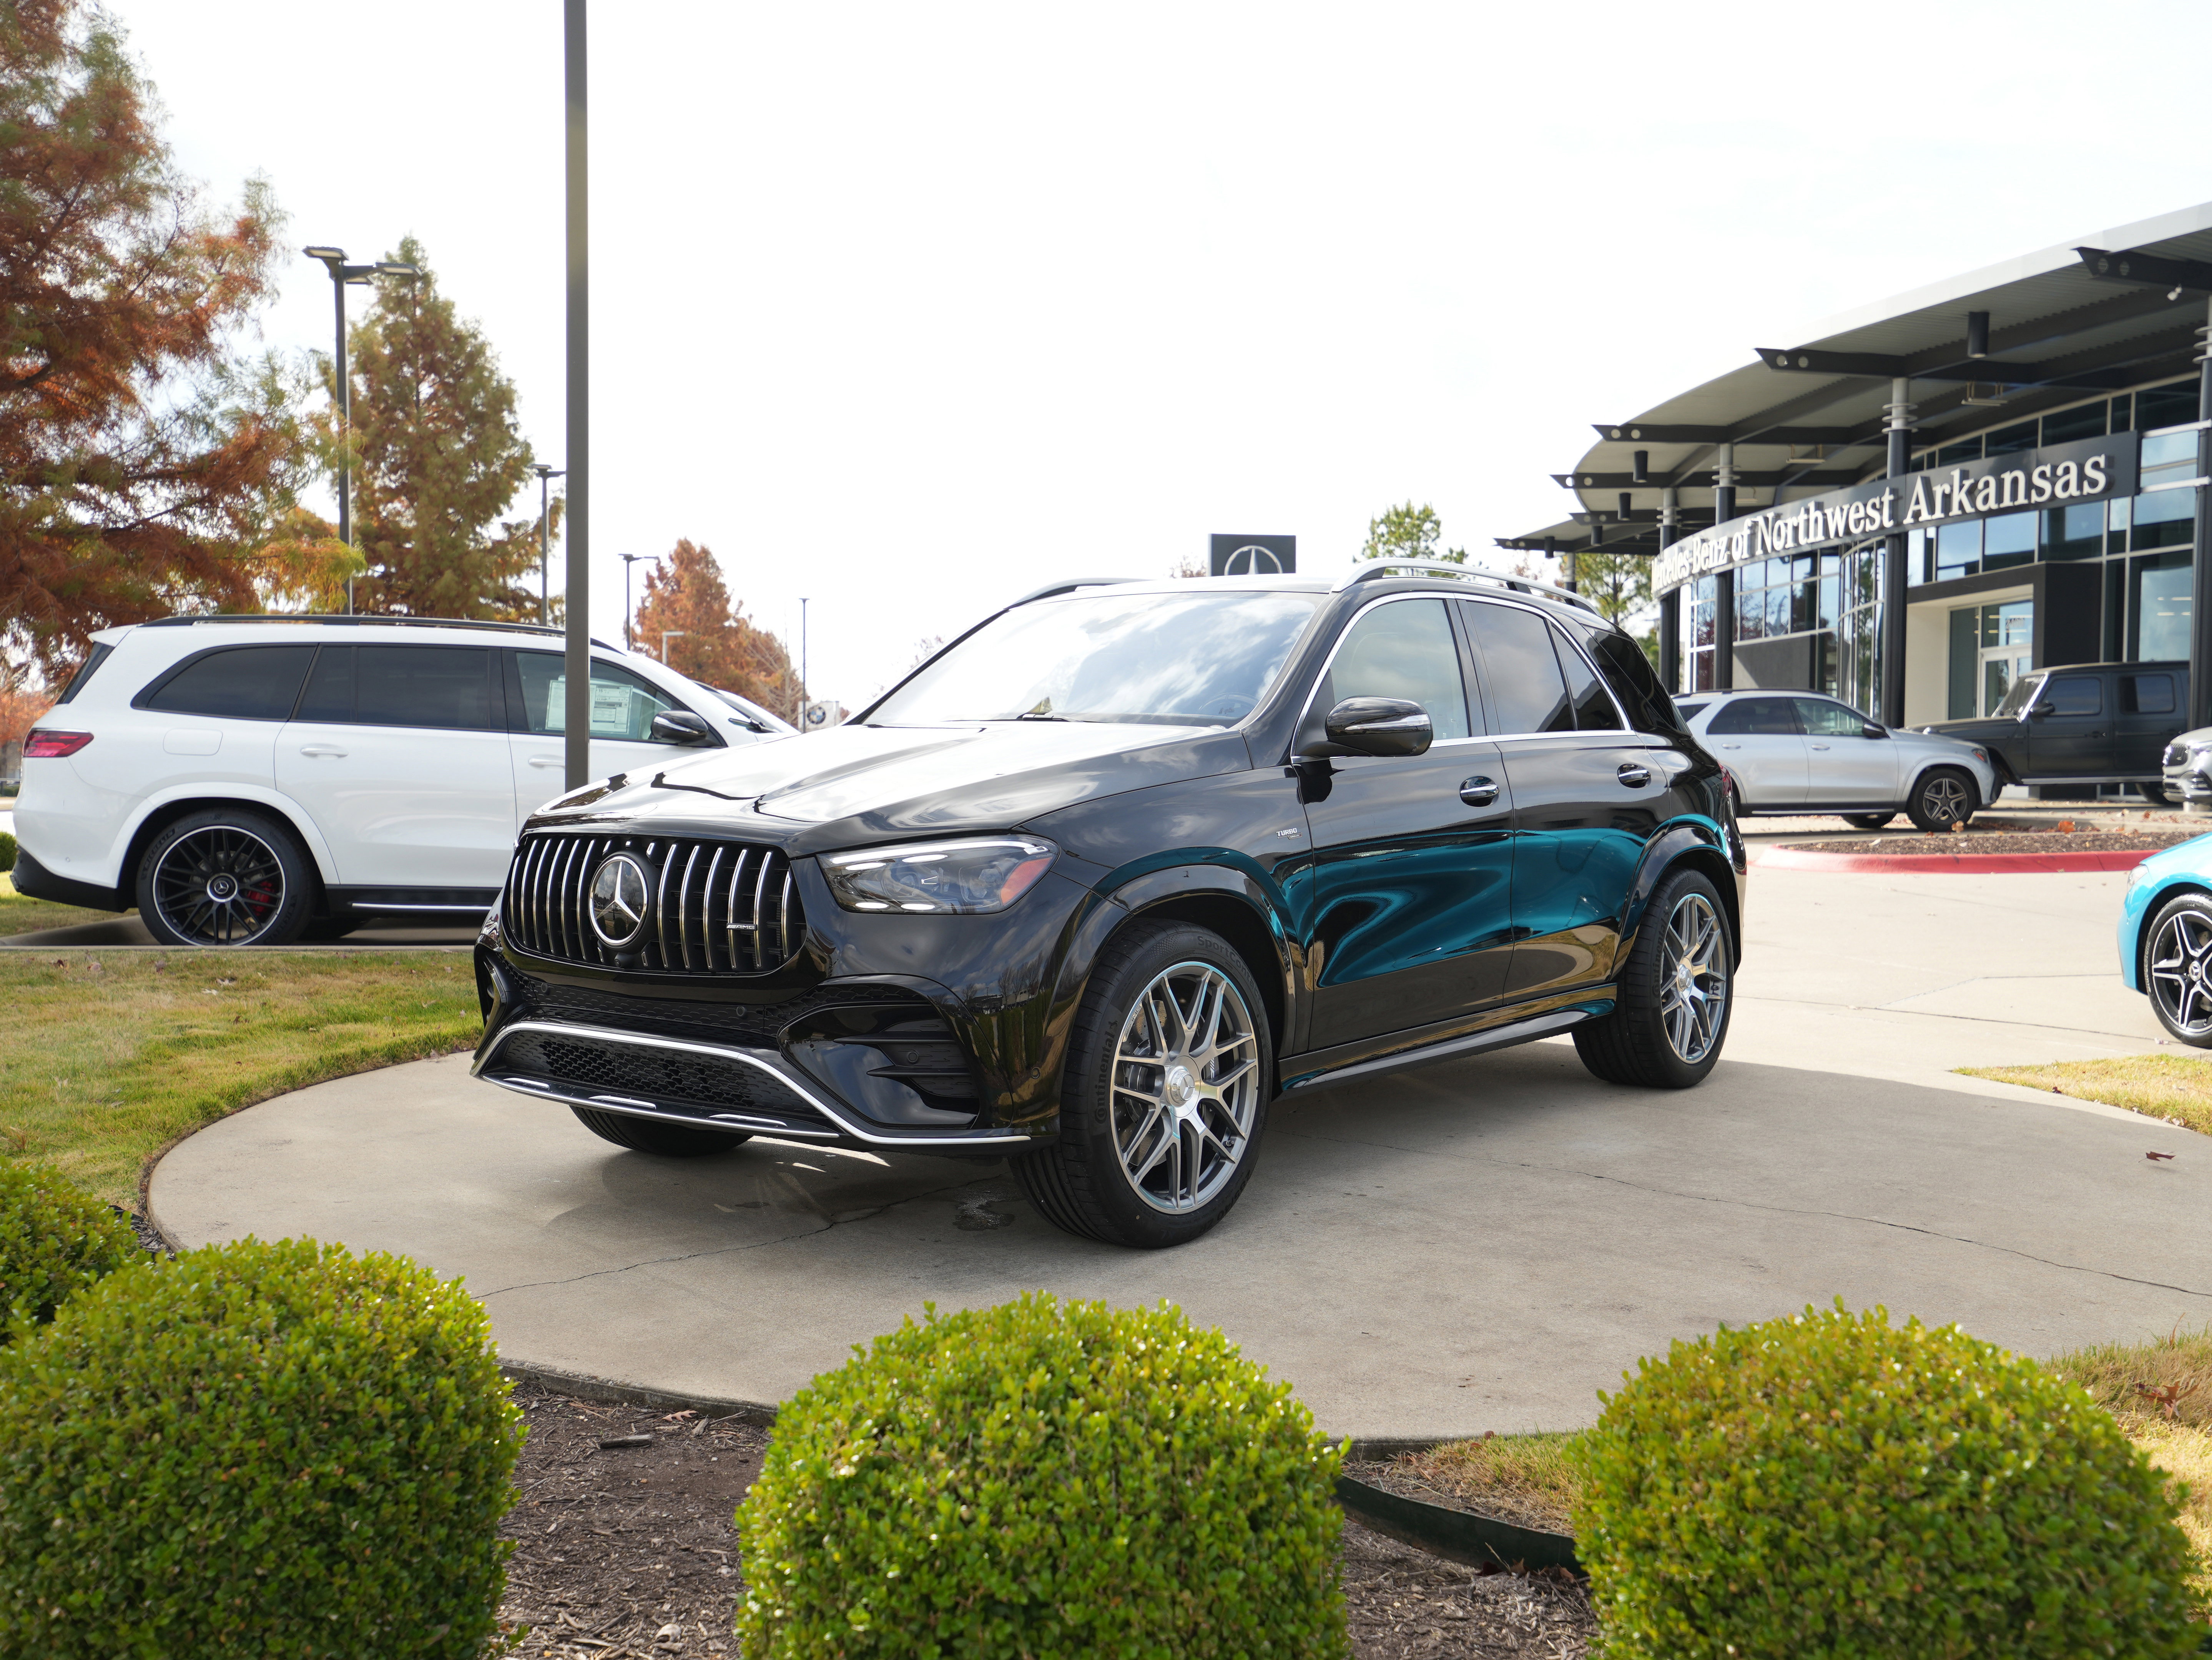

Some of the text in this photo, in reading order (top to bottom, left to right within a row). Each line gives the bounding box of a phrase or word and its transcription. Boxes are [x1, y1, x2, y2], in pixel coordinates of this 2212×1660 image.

[1732, 518, 1754, 561] of
[1755, 486, 1894, 555] Northwest
[1903, 454, 2107, 525] Arkansas
[1276, 827, 1298, 837] TURBO
[1197, 936, 1261, 1004] SportContact
[1652, 918, 1667, 998] Continental
[1094, 1031, 1115, 1124] Continental
